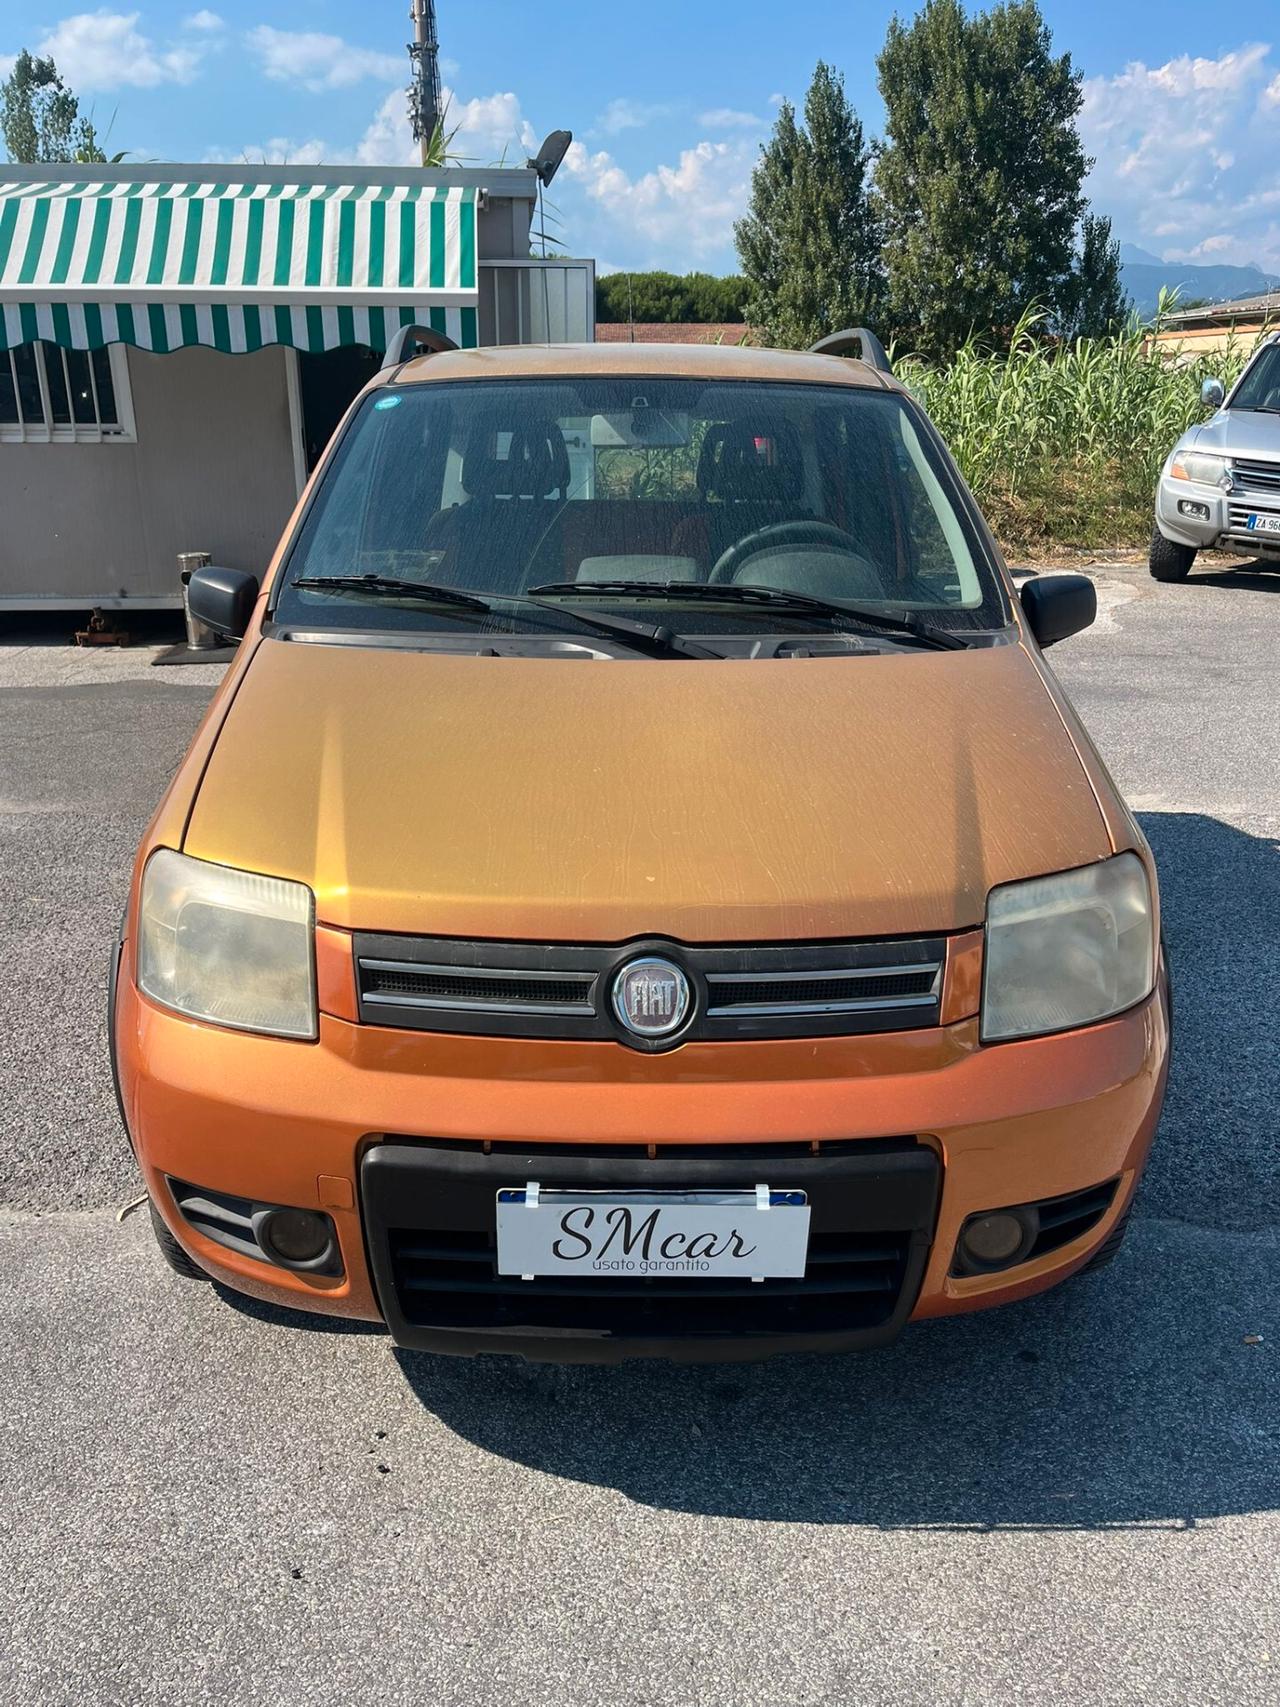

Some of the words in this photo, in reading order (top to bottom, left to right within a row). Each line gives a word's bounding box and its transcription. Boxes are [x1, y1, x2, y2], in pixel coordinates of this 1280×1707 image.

[631, 981, 675, 1016] FIAT
[552, 1207, 757, 1260] SMcar
[593, 1259, 635, 1271] usato
[640, 1258, 709, 1274] garantito
